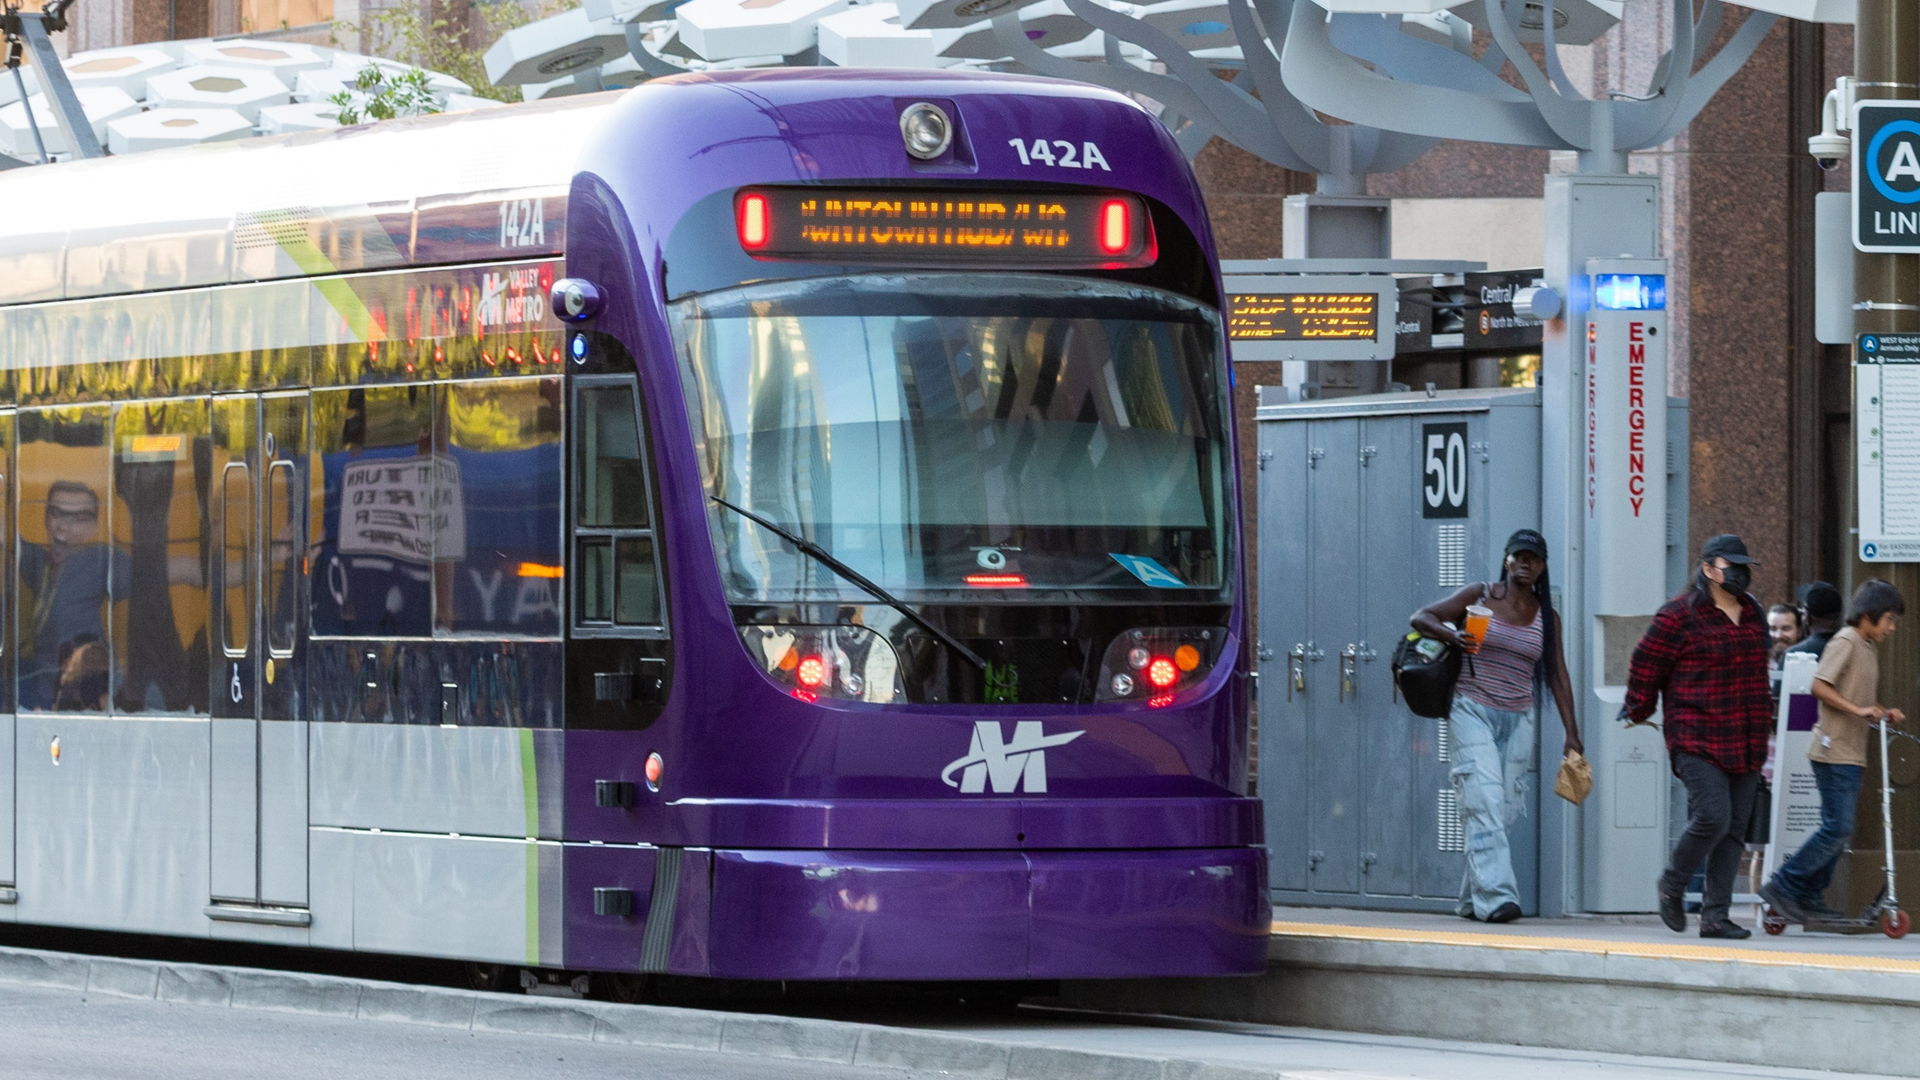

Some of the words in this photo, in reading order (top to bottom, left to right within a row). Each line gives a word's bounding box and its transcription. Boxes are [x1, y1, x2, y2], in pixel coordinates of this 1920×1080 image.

[1008, 138, 1112, 171] 142A
[1885, 141, 1920, 182] A
[499, 198, 545, 248] 142A
[1874, 211, 1920, 234] LIN
[509, 268, 539, 289] VALLEY
[505, 294, 543, 324] METRO
[1481, 284, 1512, 305] Central
[1629, 322, 1644, 517] EMERGENCY
[1425, 432, 1466, 508] 50
[1132, 560, 1183, 585] A
